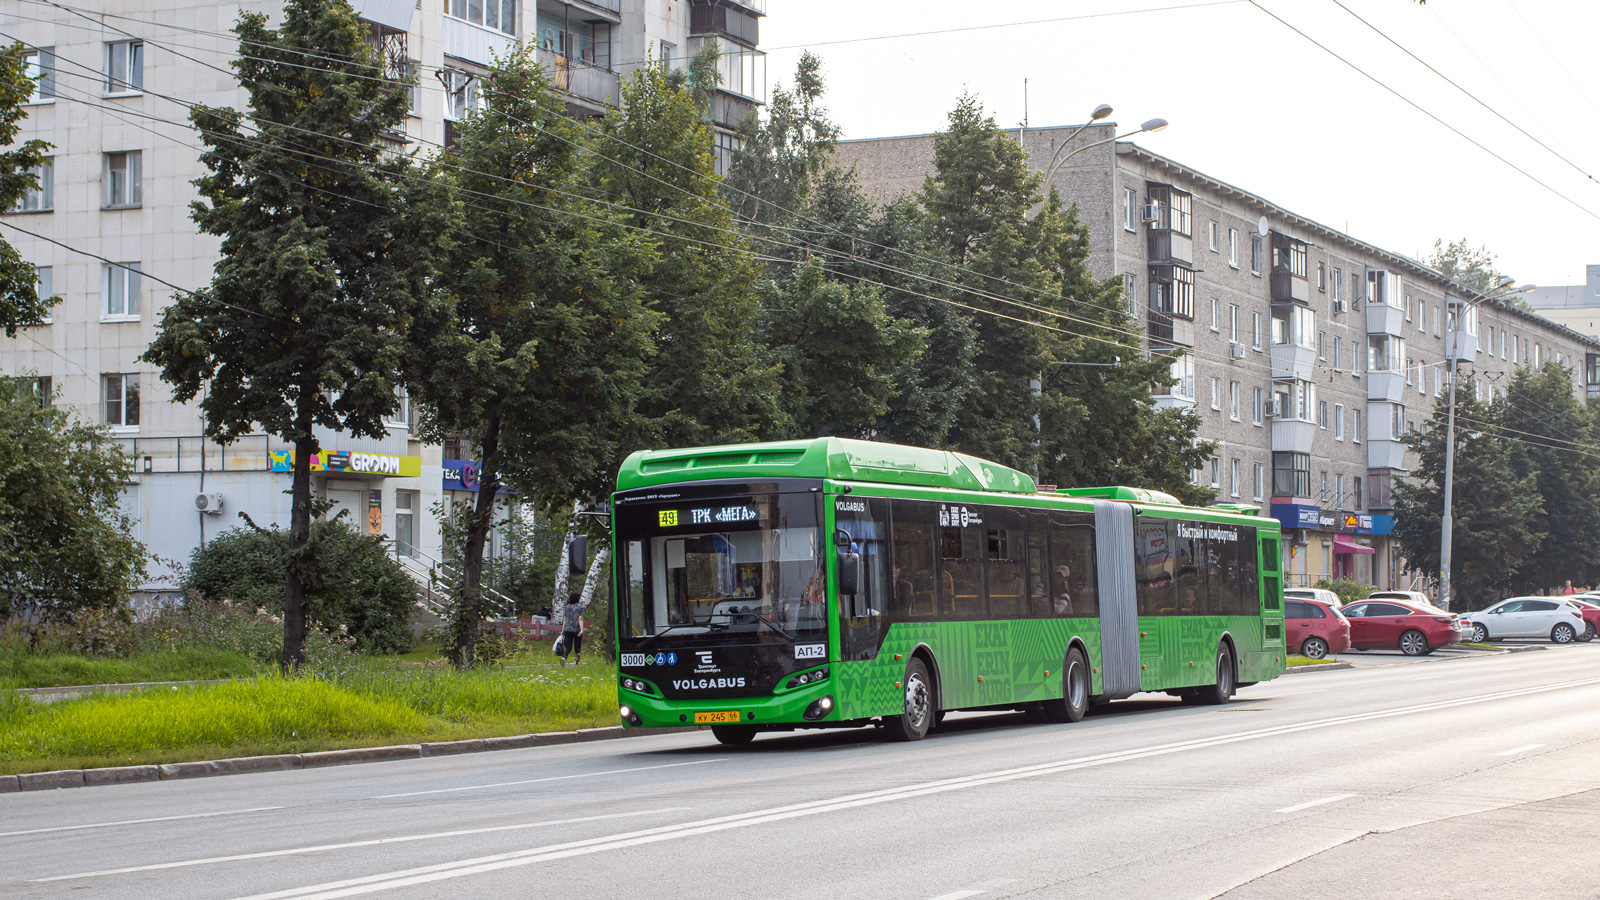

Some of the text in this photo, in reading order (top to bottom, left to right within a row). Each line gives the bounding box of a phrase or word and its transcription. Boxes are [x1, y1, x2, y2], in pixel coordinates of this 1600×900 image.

[350, 453, 400, 474] GROOM
[691, 506, 756, 523] ТРК «МЕГА»
[835, 501, 865, 512] VOLGABUS
[661, 511, 675, 525] 49
[1182, 524, 1203, 542] быстрый
[1208, 526, 1238, 544] комфортный
[975, 622, 1009, 648] EKAT
[1180, 618, 1203, 640] EKAT
[622, 655, 644, 665] 3000
[797, 646, 824, 657] АП-2
[1181, 641, 1204, 663] ERIN
[976, 650, 1010, 677] ERIN
[673, 677, 746, 690] VOLGABUS
[979, 678, 1012, 705] BURG
[710, 712, 726, 721] 245
